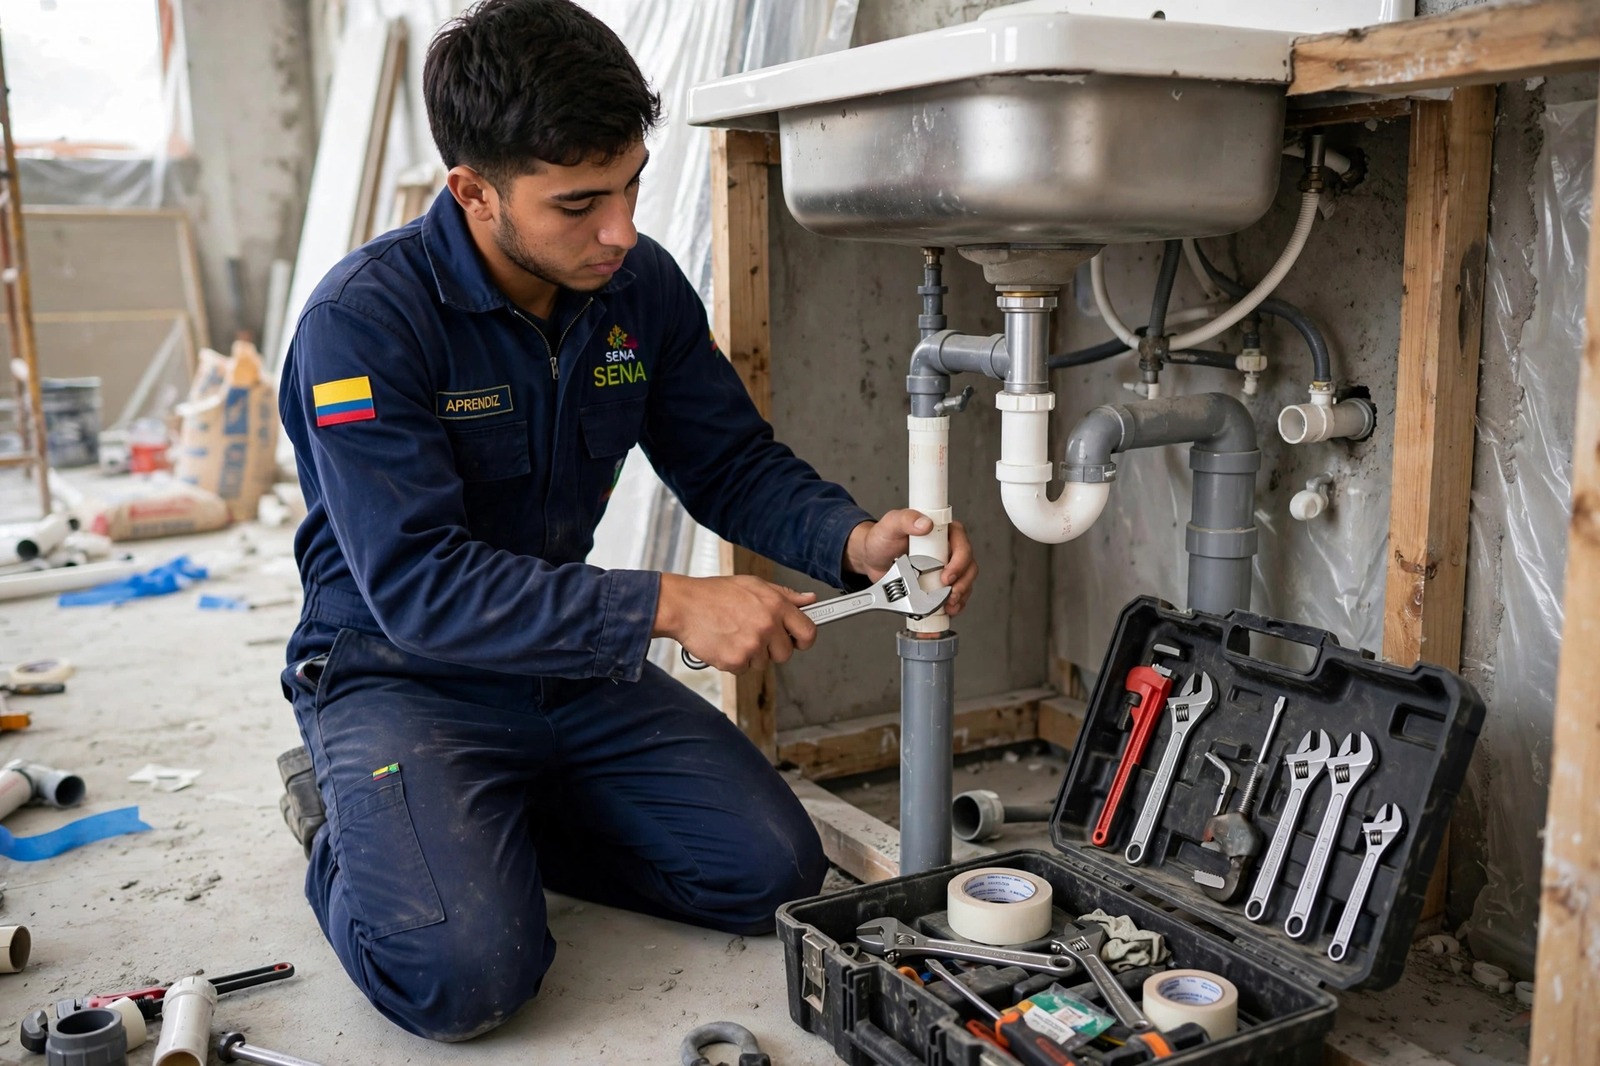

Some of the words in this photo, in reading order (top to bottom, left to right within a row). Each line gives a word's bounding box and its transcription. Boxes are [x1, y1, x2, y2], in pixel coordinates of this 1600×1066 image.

[605, 349, 635, 362] SENA
[593, 361, 646, 386] SENA
[445, 394, 500, 412] APRENDIZ
